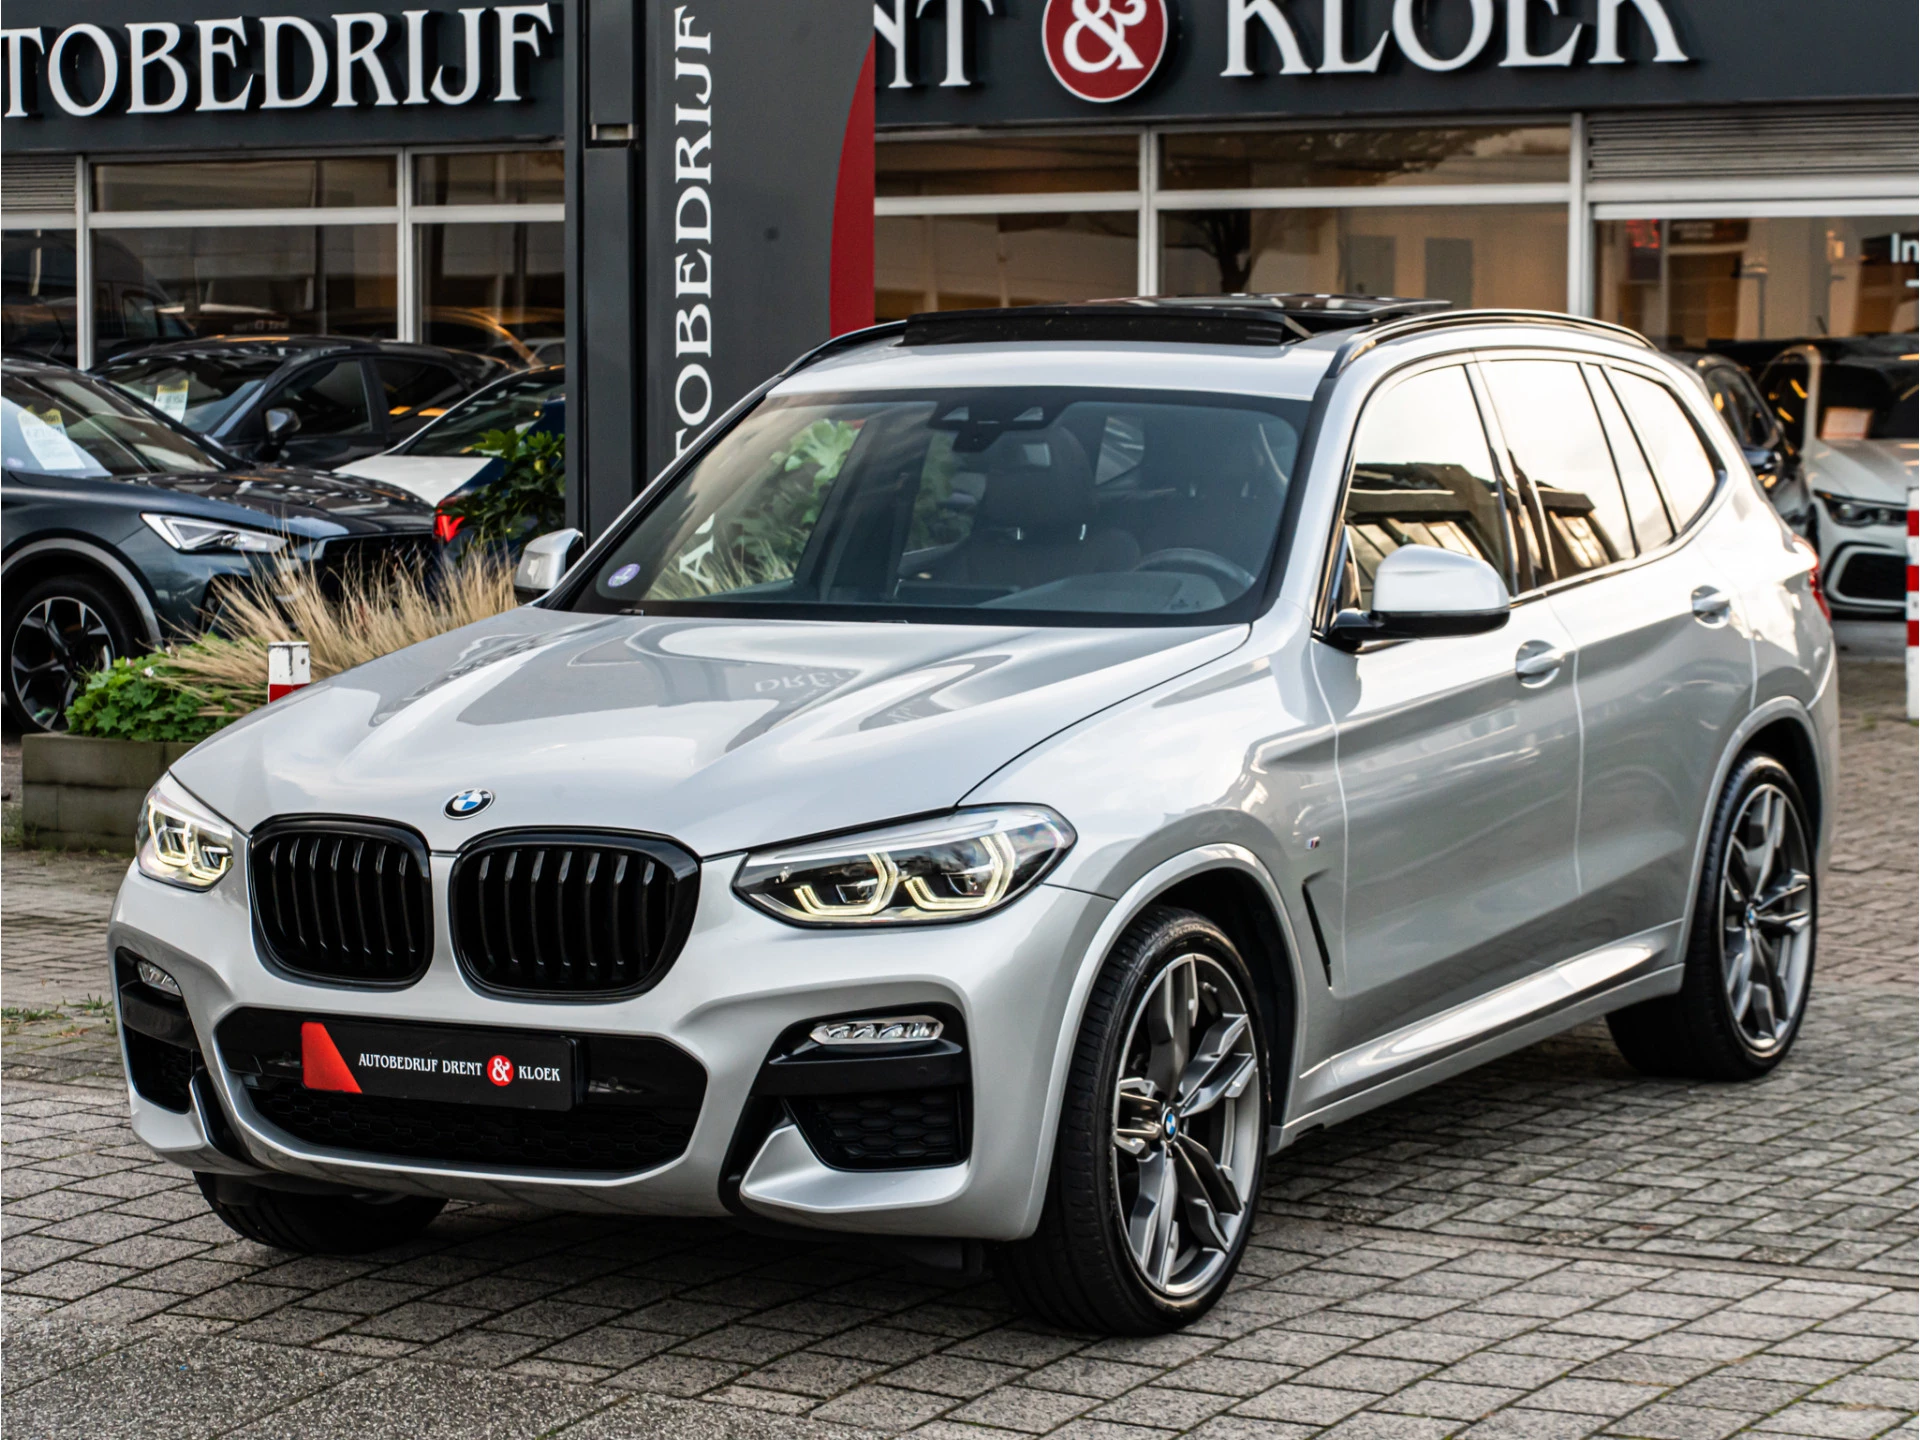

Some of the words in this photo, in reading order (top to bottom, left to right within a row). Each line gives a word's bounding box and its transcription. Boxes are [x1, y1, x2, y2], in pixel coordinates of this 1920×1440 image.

[1, 3, 554, 118] TOBEDRIJF
[358, 1053, 438, 1073] AUTOBEDRIJF
[442, 1060, 482, 1076] DRENT
[491, 1059, 510, 1082] &
[518, 1066, 561, 1082] KLOEK
